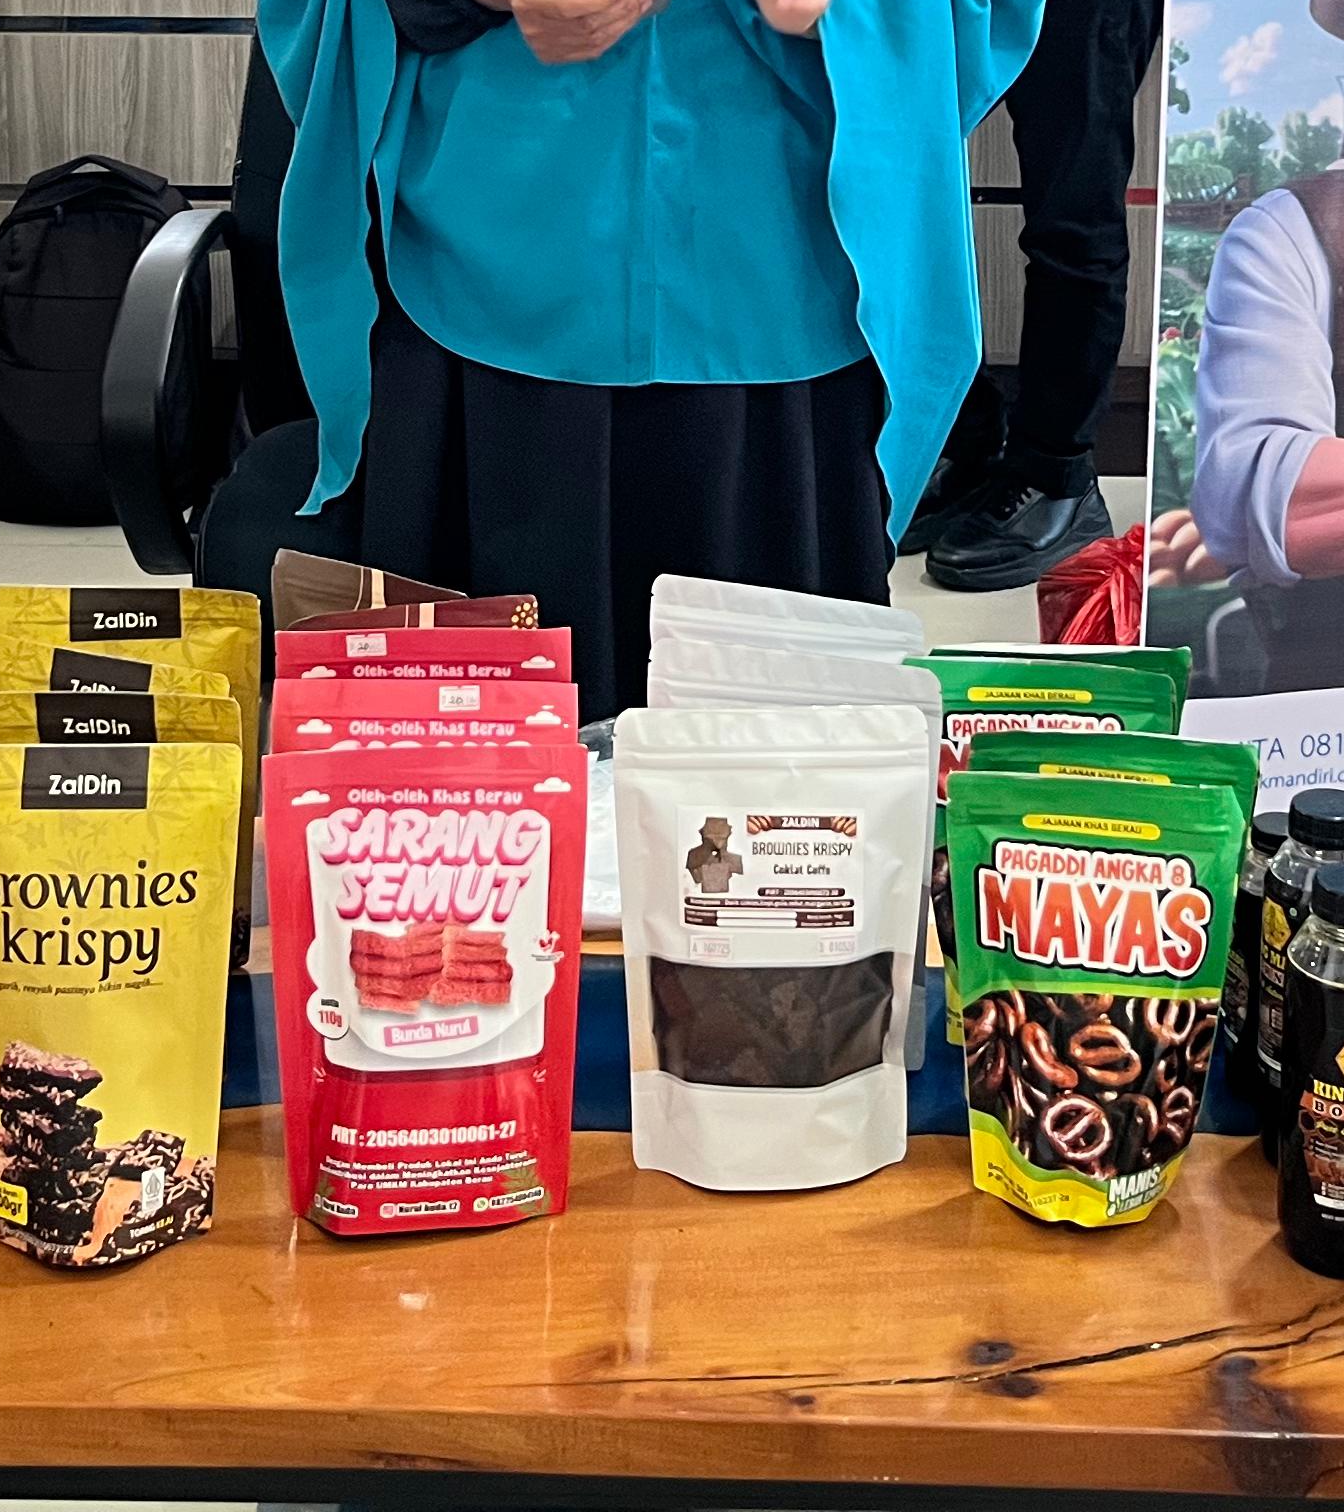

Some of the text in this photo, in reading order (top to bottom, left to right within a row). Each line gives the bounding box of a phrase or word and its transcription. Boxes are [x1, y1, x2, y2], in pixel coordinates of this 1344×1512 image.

[93, 612, 158, 630] ZalDin
[353, 664, 511, 678] Oleh-oleh Khas Berau
[62, 718, 131, 737] ZalDin
[349, 720, 515, 737] Oleh-oleh Khas Berau
[48, 774, 121, 796] ZalDin
[348, 789, 523, 804] Oleh-oleh Khas Berau
[781, 817, 820, 828] ZALDIN
[1041, 818, 1143, 834] JAJANAN KHAS BERAU
[320, 807, 543, 866] SARANG
[752, 841, 853, 856] BROWNIES KRISPY
[1000, 849, 1187, 886] PAGADDI ANGKA 8
[336, 863, 532, 922] SEMUT
[982, 876, 1207, 972] MAYAS
[0, 912, 162, 982] krispy
[391, 1018, 473, 1043] Bunda Nurul
[1109, 1166, 1160, 1202] MANIS
